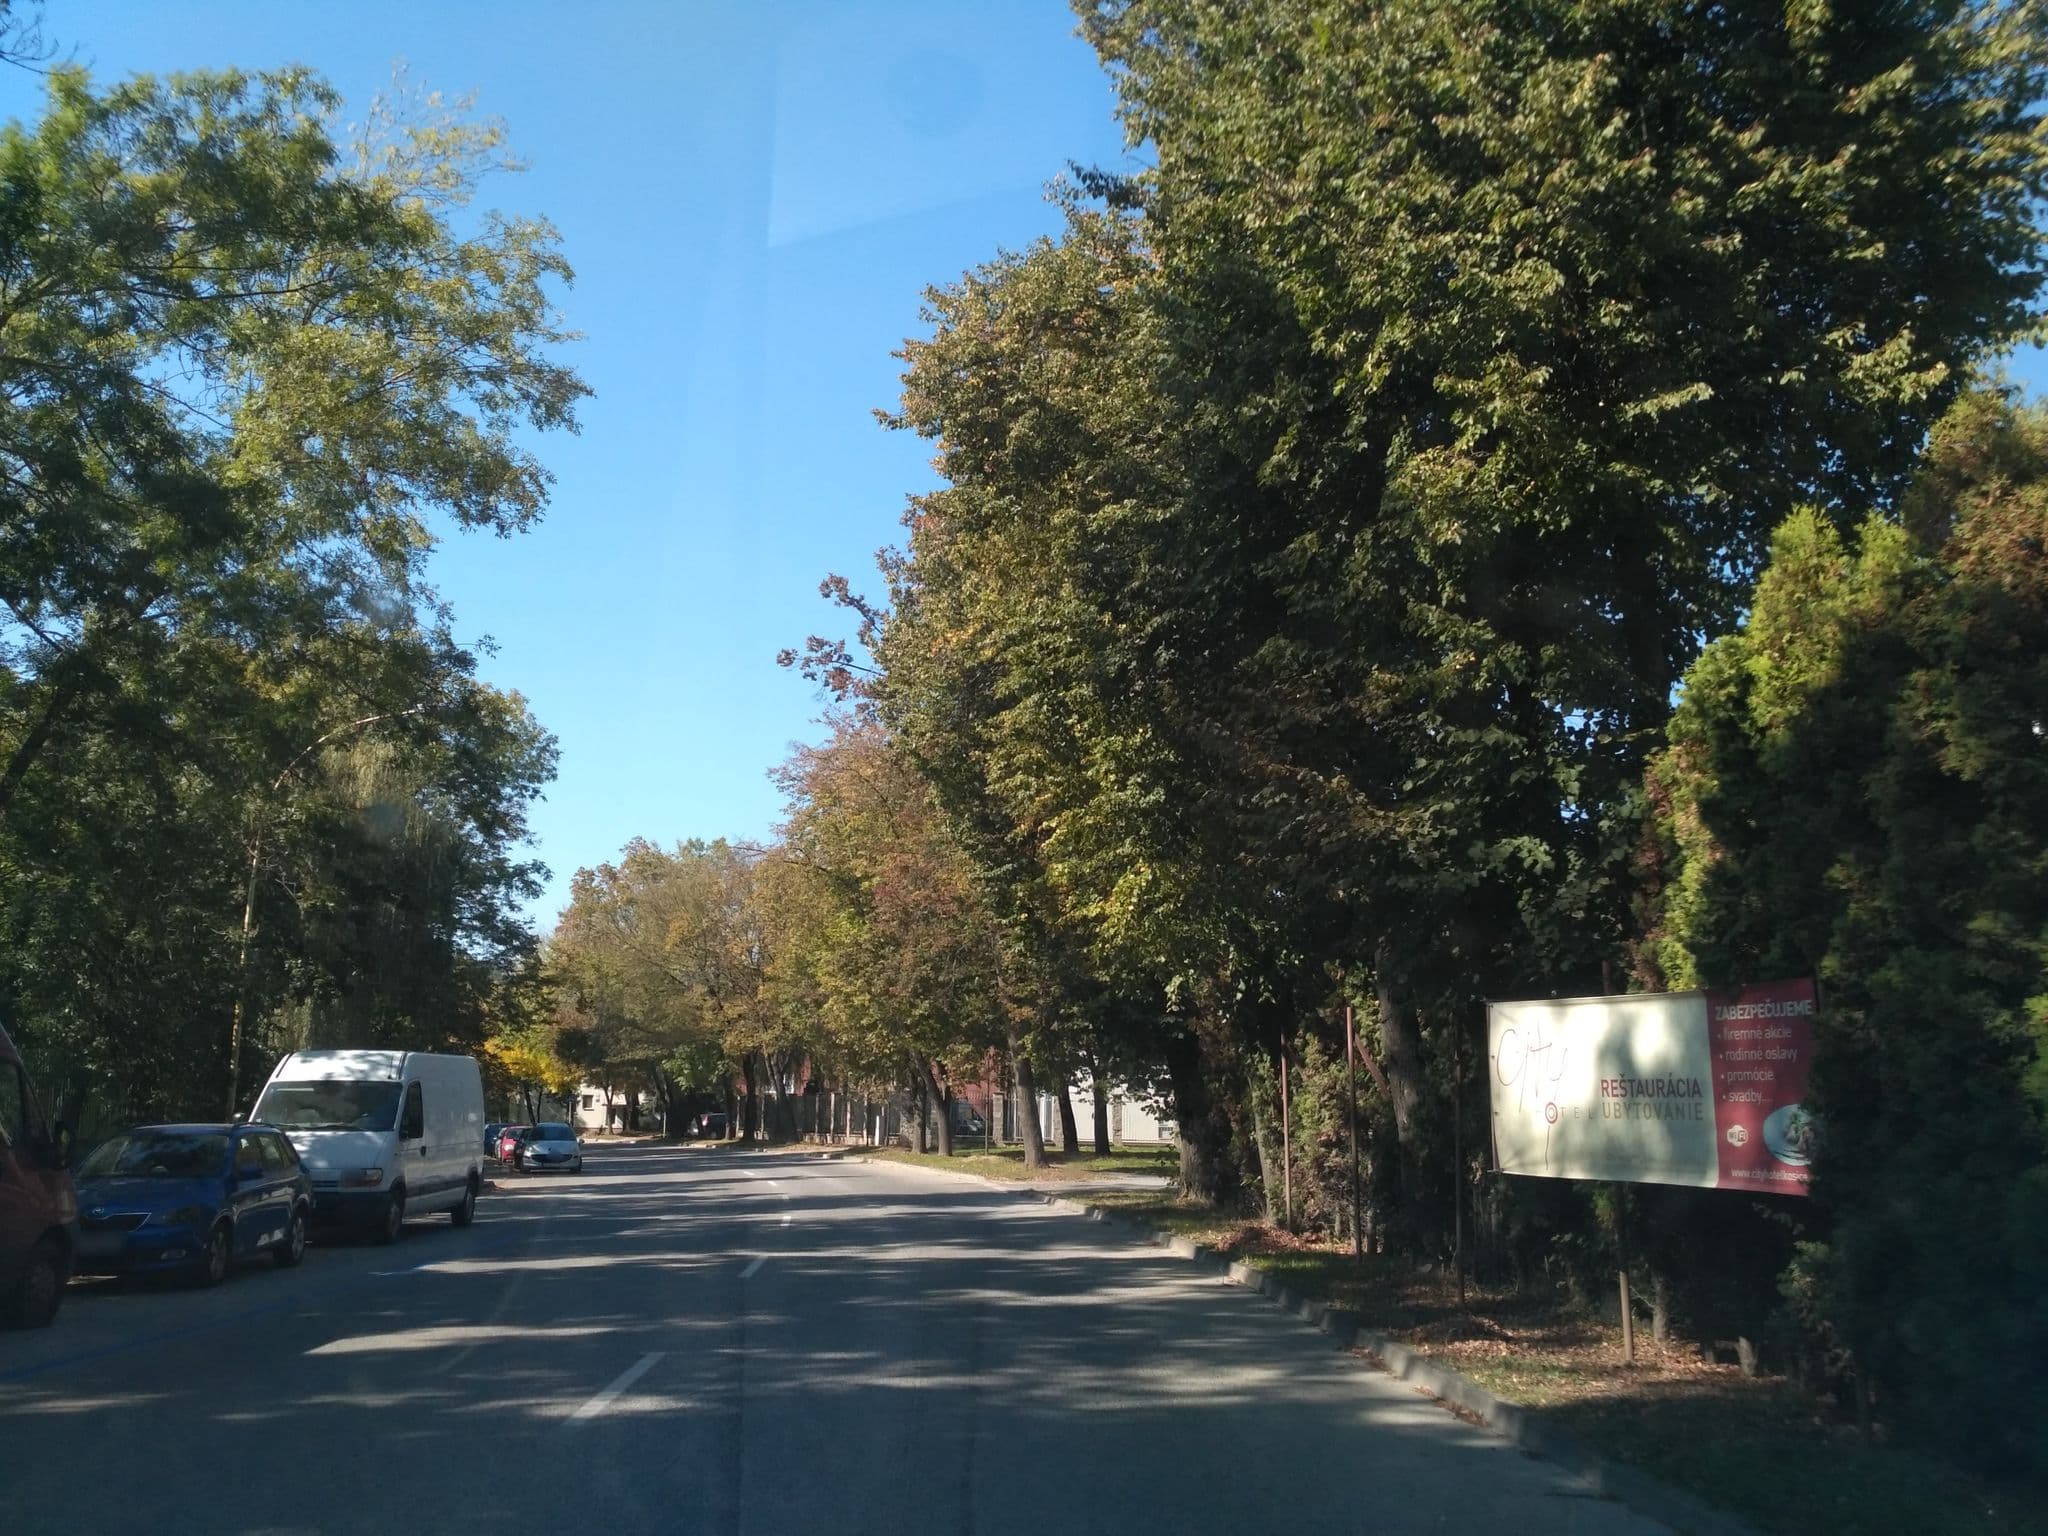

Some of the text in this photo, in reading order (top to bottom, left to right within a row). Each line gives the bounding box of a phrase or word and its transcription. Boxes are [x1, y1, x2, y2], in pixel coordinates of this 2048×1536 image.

[1715, 1000, 1813, 1021] ZABEZPEČUJEME
[1764, 1025, 1791, 1040] akcie
[1725, 1045, 1798, 1062] rodinné oslavy
[1727, 1067, 1775, 1085] promócie
[1600, 1073, 1703, 1098] REŠTAURÁCIA
[1602, 1102, 1704, 1120] UBYTOVANIE
